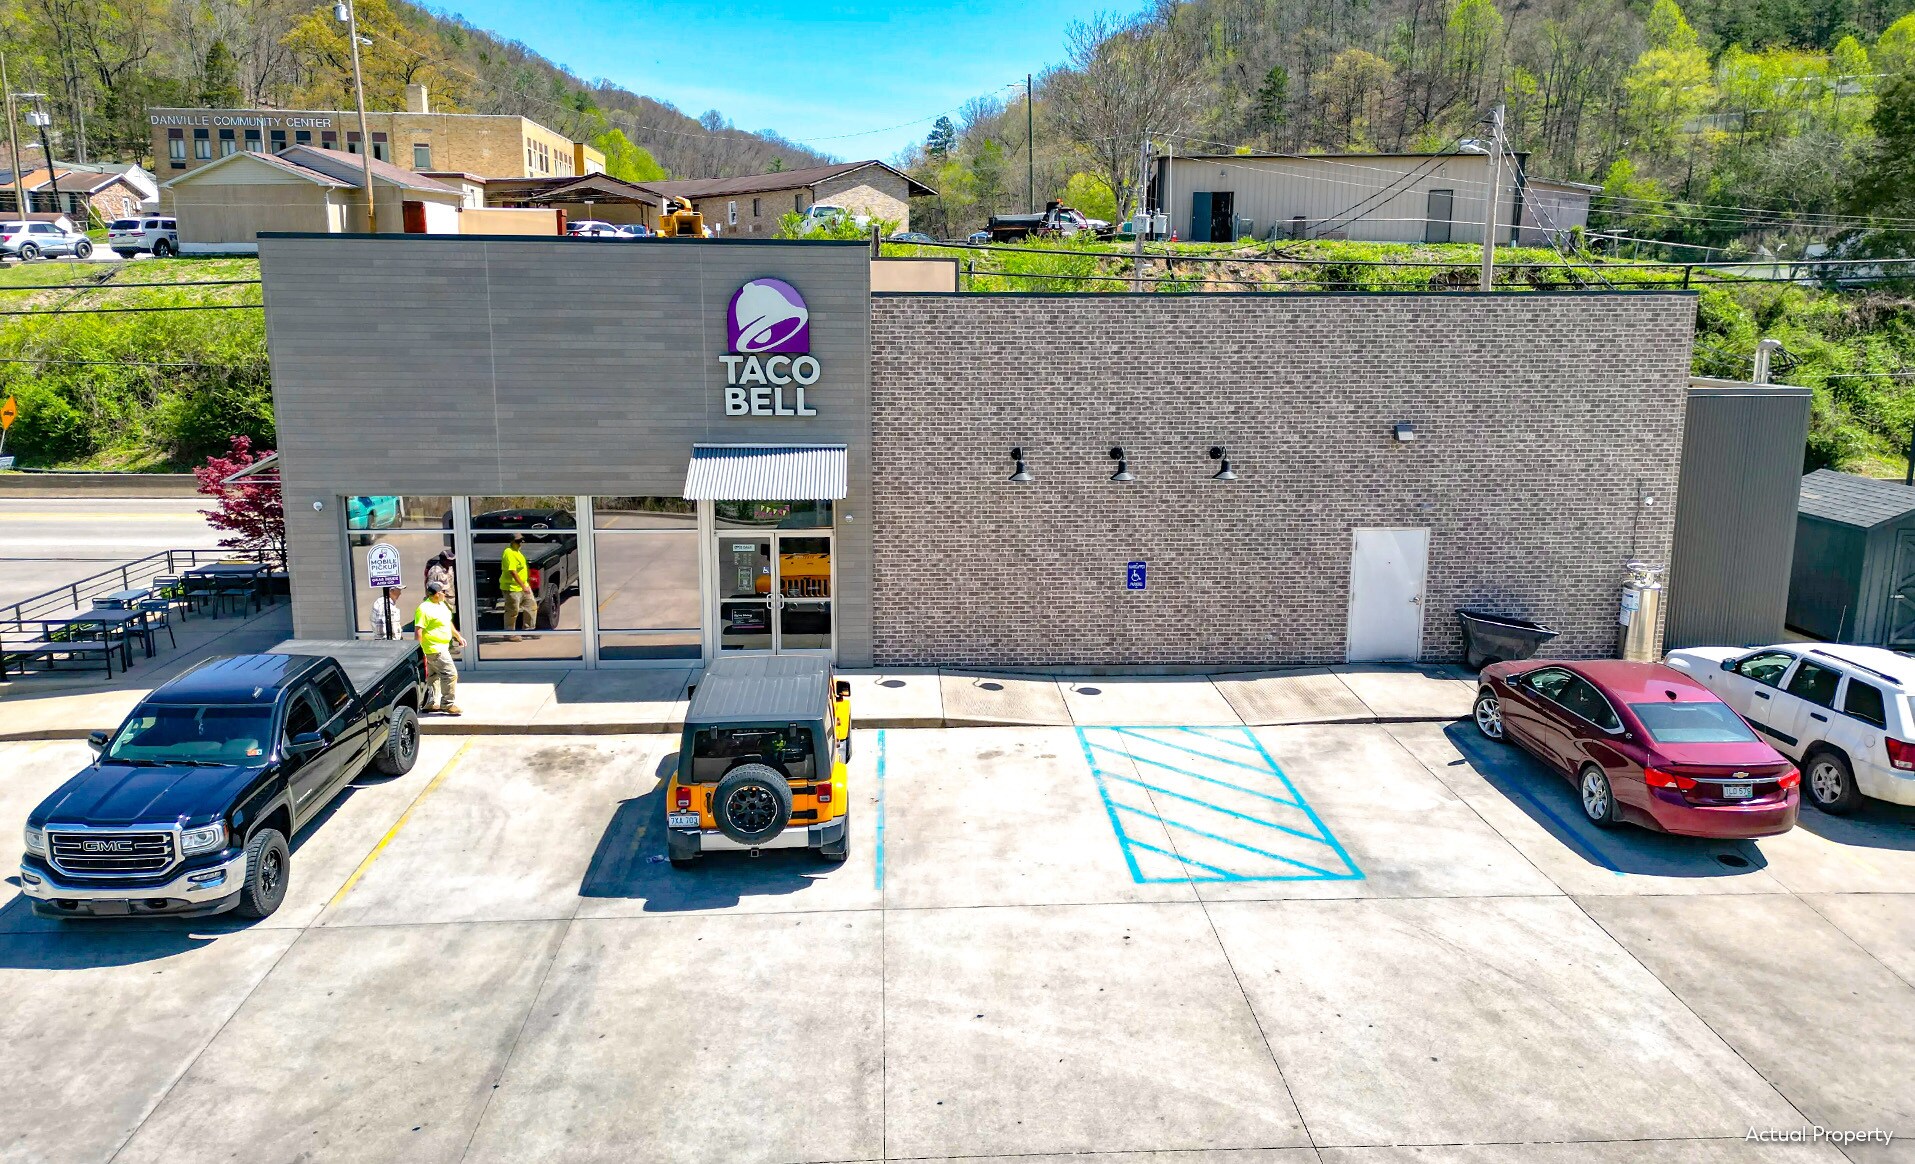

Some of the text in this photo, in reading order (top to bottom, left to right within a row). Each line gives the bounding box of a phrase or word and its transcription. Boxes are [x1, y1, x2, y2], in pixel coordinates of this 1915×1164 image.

[151, 115, 331, 128] DANVILLE COMMUNITY CENTER
[718, 355, 821, 386] TACO
[724, 387, 817, 416] BELL
[83, 840, 132, 852] GMC
